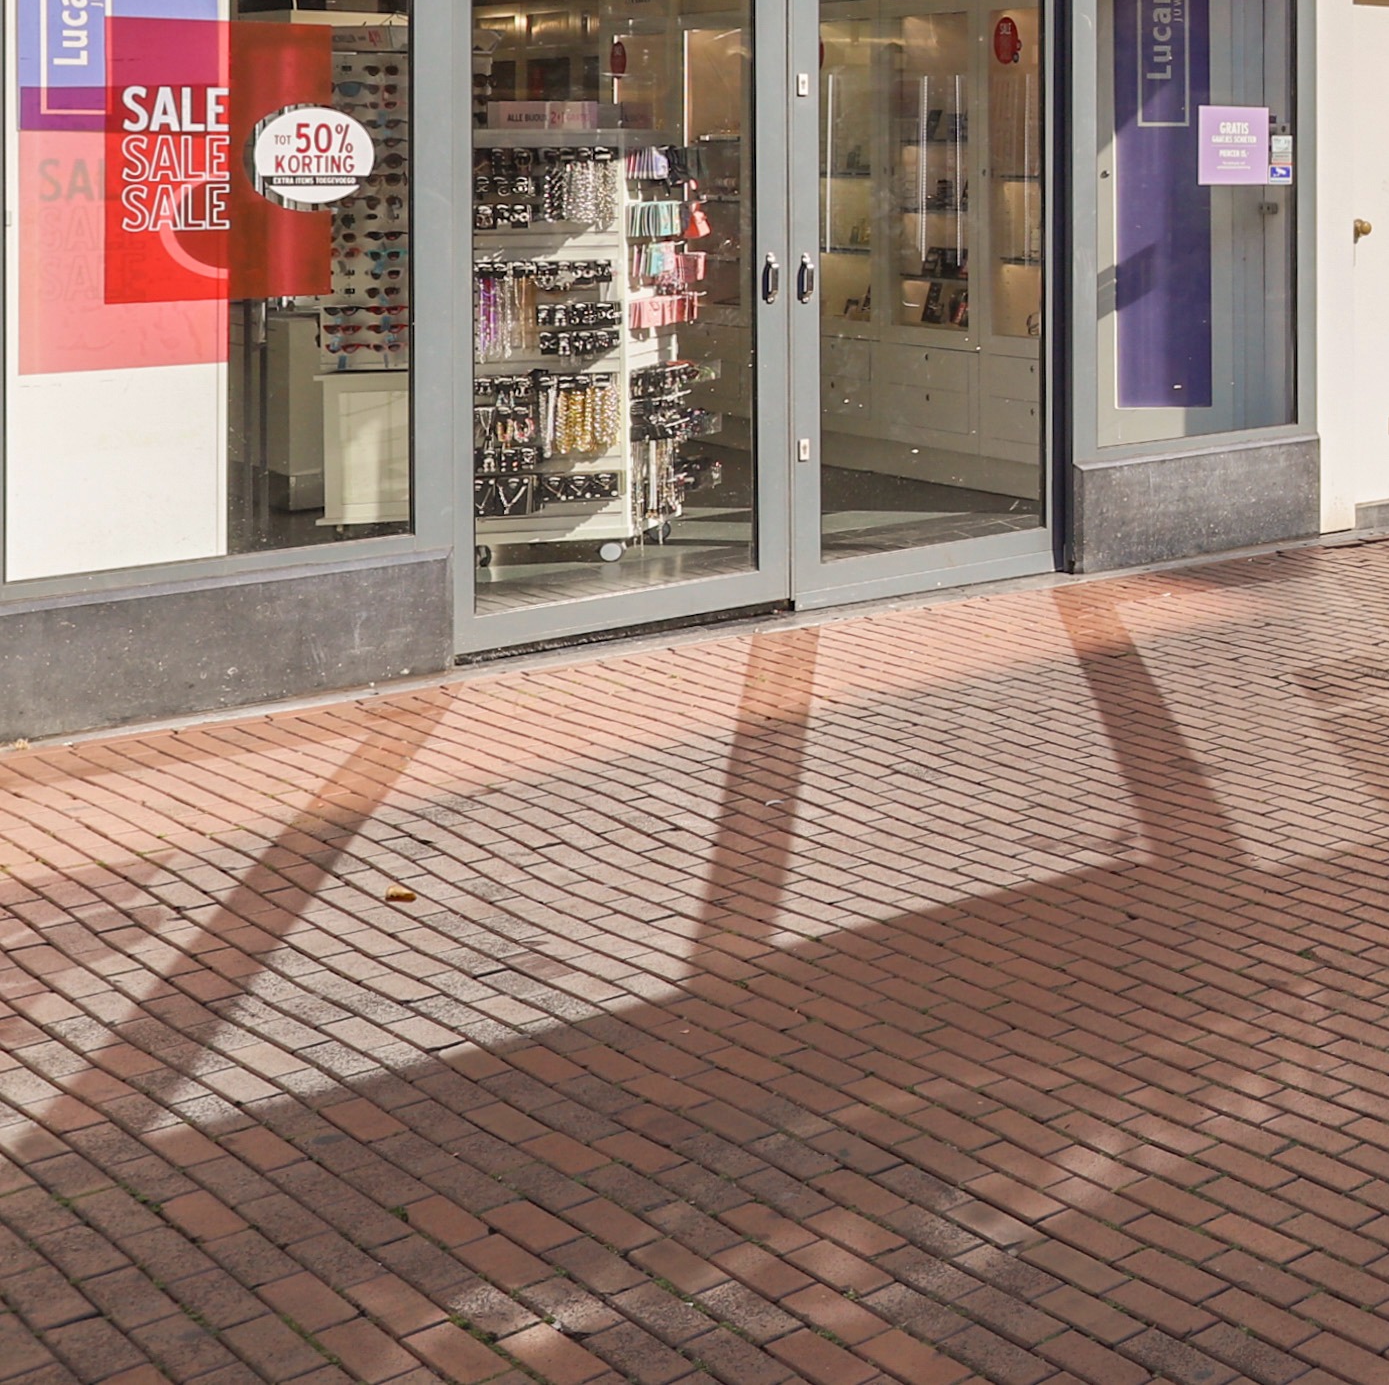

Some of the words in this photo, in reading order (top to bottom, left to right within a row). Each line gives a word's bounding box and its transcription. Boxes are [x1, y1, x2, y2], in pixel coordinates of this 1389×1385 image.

[122, 86, 230, 132] SALE
[274, 134, 292, 145] TOT
[295, 122, 354, 154] 50%
[1219, 122, 1249, 134] GRATIS
[122, 134, 230, 182] SALE
[274, 155, 356, 174] KORTING
[272, 177, 295, 185] EXTRA
[122, 183, 230, 232] SALE
